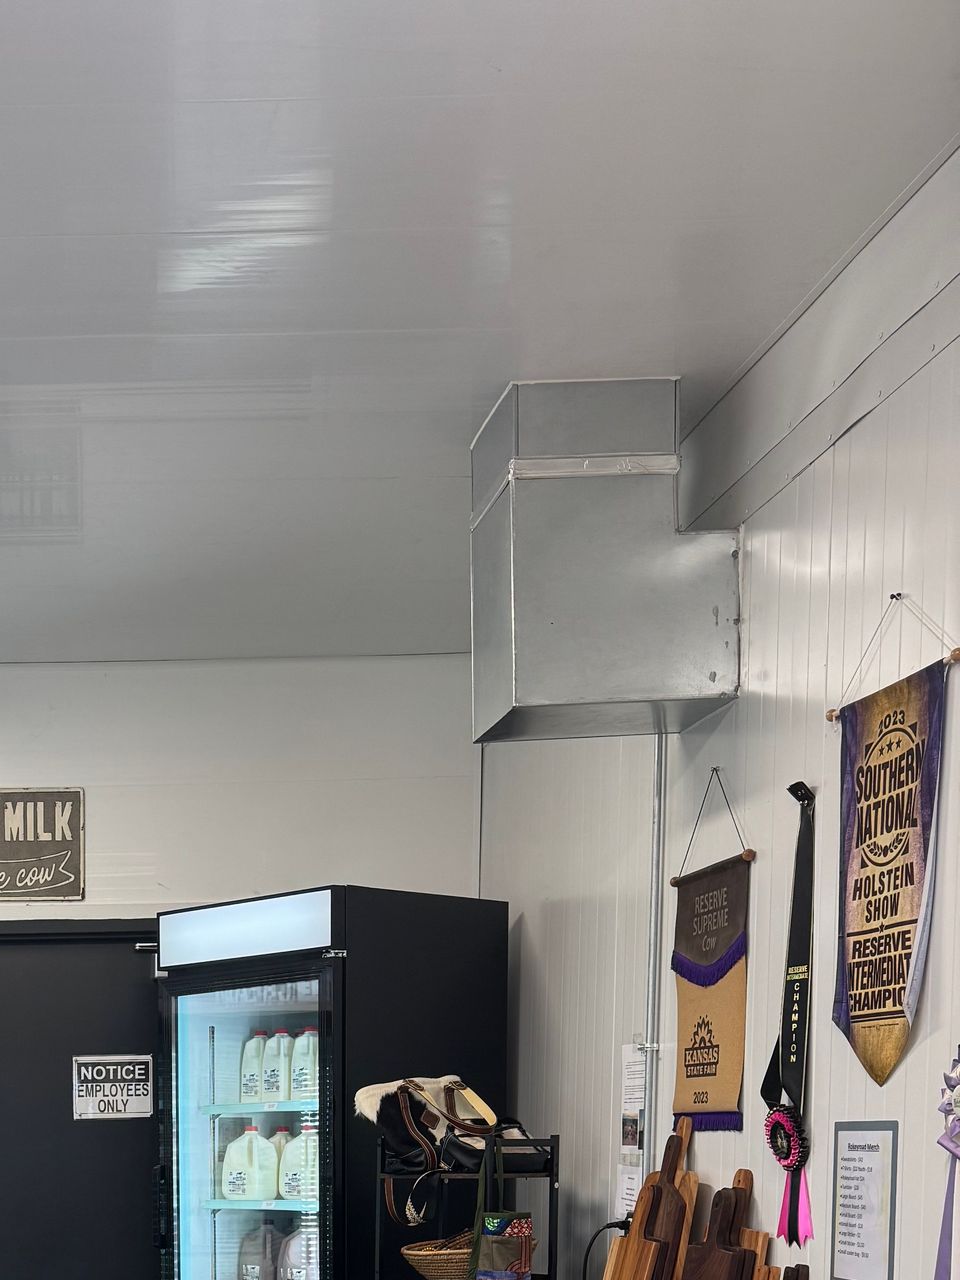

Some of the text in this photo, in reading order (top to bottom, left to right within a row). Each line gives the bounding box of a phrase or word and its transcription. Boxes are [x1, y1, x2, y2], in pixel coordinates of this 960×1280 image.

[878, 710, 906, 736] 2023
[856, 738, 925, 804] SOUTHERN
[4, 801, 73, 842] MILK
[855, 785, 918, 850] NATIONAL
[16, 863, 57, 888] cow
[852, 862, 915, 901] HOLSTEIN
[694, 888, 728, 914] RESERVE
[865, 892, 901, 923] SHOW
[692, 908, 729, 936] SUPREME
[852, 930, 912, 960] RESERVE
[790, 982, 800, 1063] CHAMPION
[686, 1048, 718, 1065] KANSAS
[81, 1065, 146, 1080] NOTICE
[687, 1065, 715, 1076] STATE FAIR
[78, 1084, 149, 1098] EMPLOYEES
[693, 1091, 708, 1104] 2023
[98, 1099, 129, 1113] ONLY
